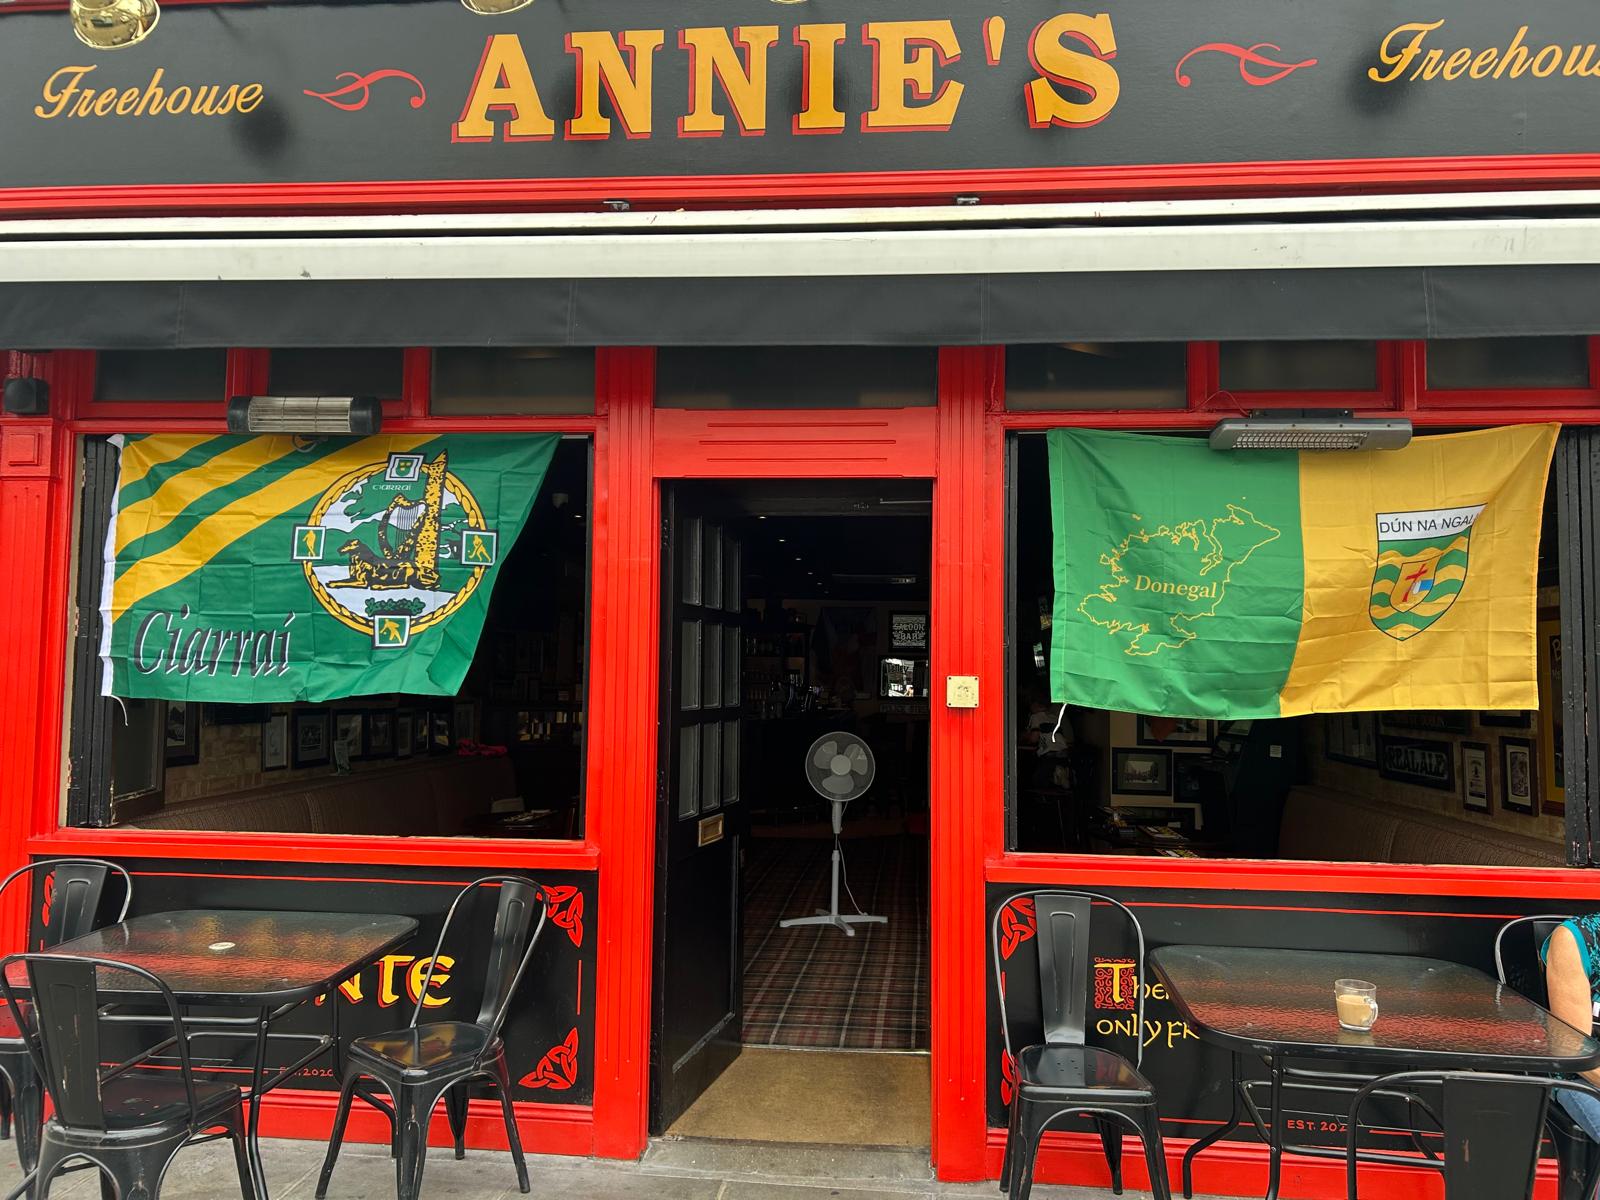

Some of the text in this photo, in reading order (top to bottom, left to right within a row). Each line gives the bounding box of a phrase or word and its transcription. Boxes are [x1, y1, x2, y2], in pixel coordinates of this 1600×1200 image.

[451, 13, 1121, 143] ANNIE'S
[1367, 18, 1600, 85] Freehou
[34, 65, 265, 119] Freehouse
[1379, 517, 1413, 534] DÚN
[1417, 519, 1438, 532] NA
[1134, 575, 1217, 602] Donegal
[133, 603, 297, 679] Ciarraí
[314, 955, 455, 1008] NTE
[1094, 963, 1170, 1003] The
[1287, 1120, 1316, 1131] EST.
